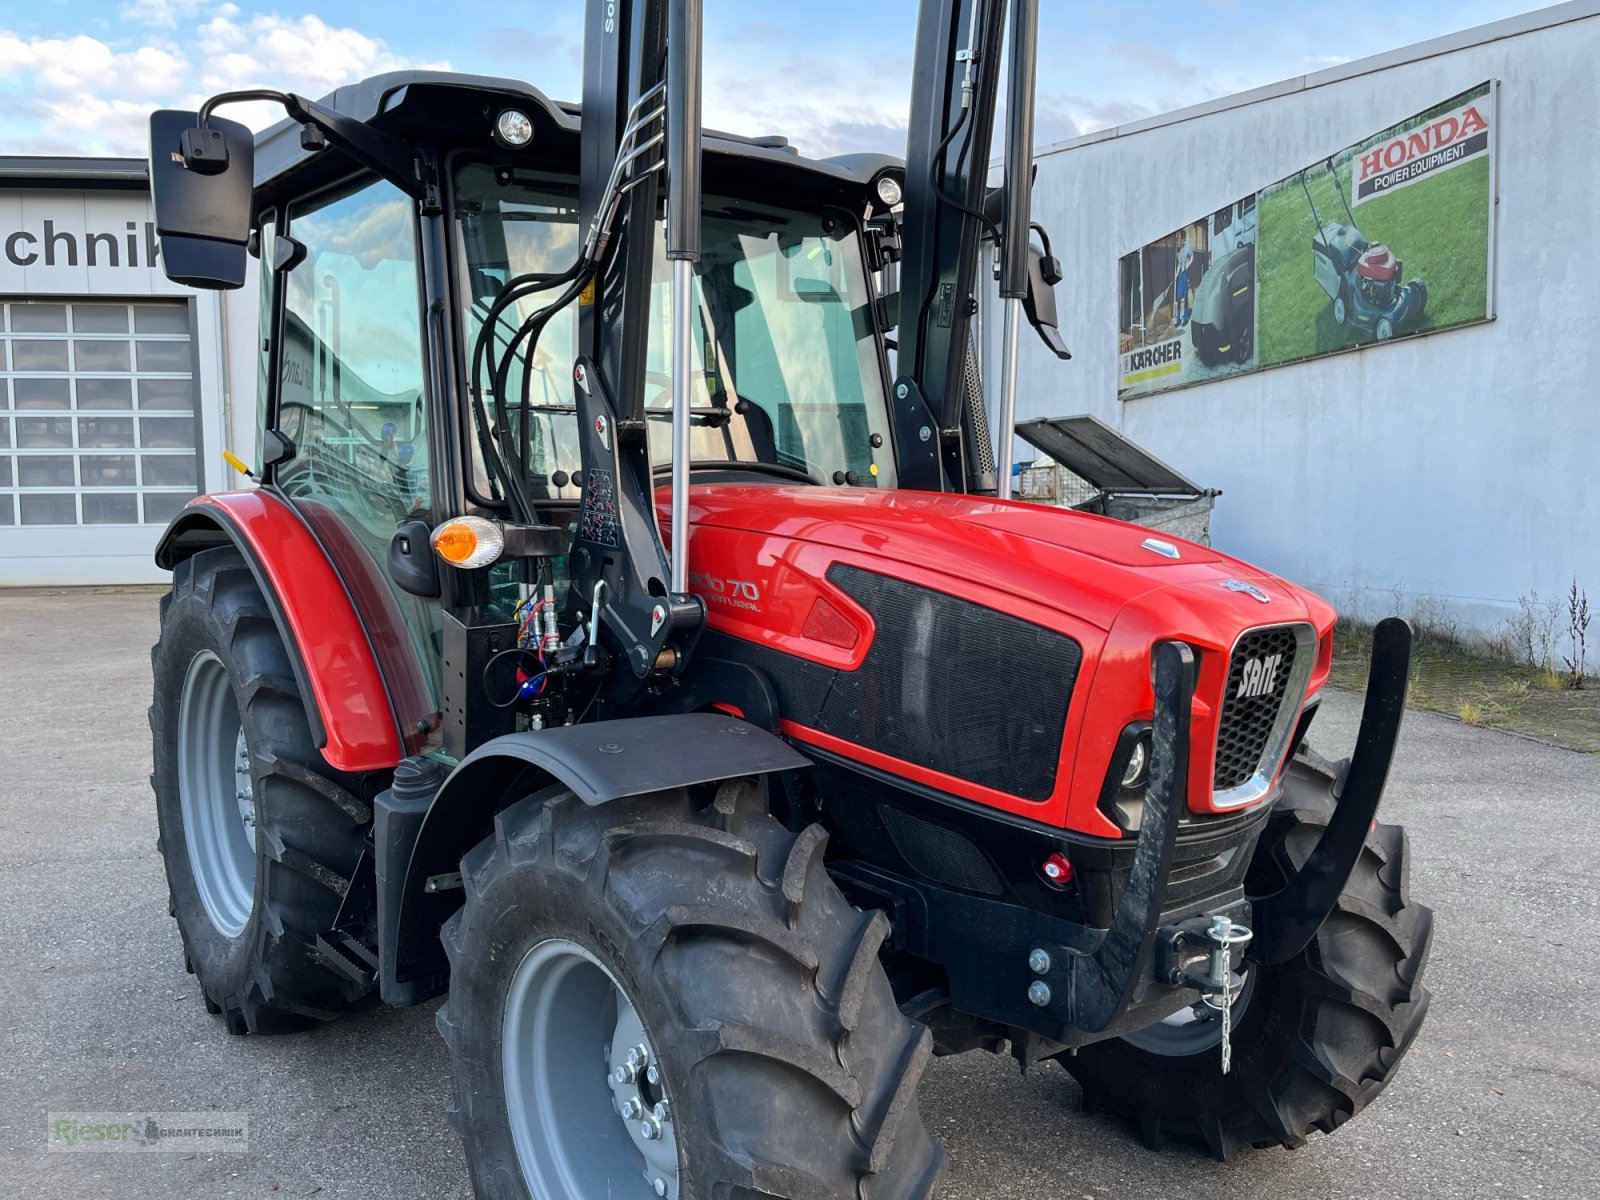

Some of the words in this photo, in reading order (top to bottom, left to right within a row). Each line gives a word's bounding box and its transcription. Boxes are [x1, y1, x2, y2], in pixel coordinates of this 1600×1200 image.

[1360, 106, 1487, 181] HONDA
[1374, 168, 1410, 190] POWER
[1410, 143, 1466, 177] EQUIPMENT
[1130, 340, 1182, 372] KÄRCHER
[726, 579, 760, 601] 70
[1237, 654, 1282, 698] SAME
